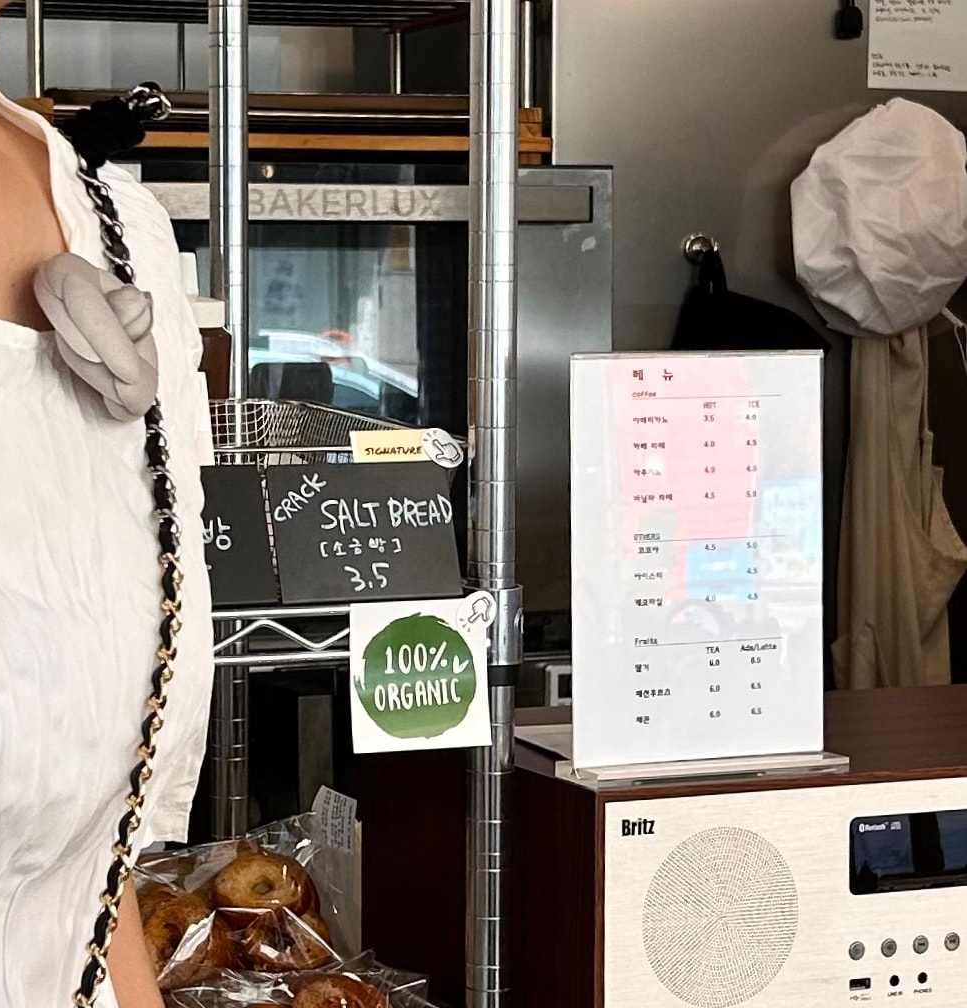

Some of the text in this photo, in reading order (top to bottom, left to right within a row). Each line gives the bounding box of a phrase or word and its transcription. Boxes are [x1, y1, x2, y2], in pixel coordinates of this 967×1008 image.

[249, 188, 442, 218] BAKERLUX
[748, 400, 761, 408] ICE
[365, 446, 423, 456] SIGNATURE
[273, 472, 328, 523] CRACK
[320, 493, 453, 535] SALT BREAD
[343, 562, 390, 592] 3.5
[384, 641, 448, 675] 100%
[705, 646, 720, 654] TEA
[374, 677, 461, 711] ORGANIC
[621, 817, 656, 837] Britz
